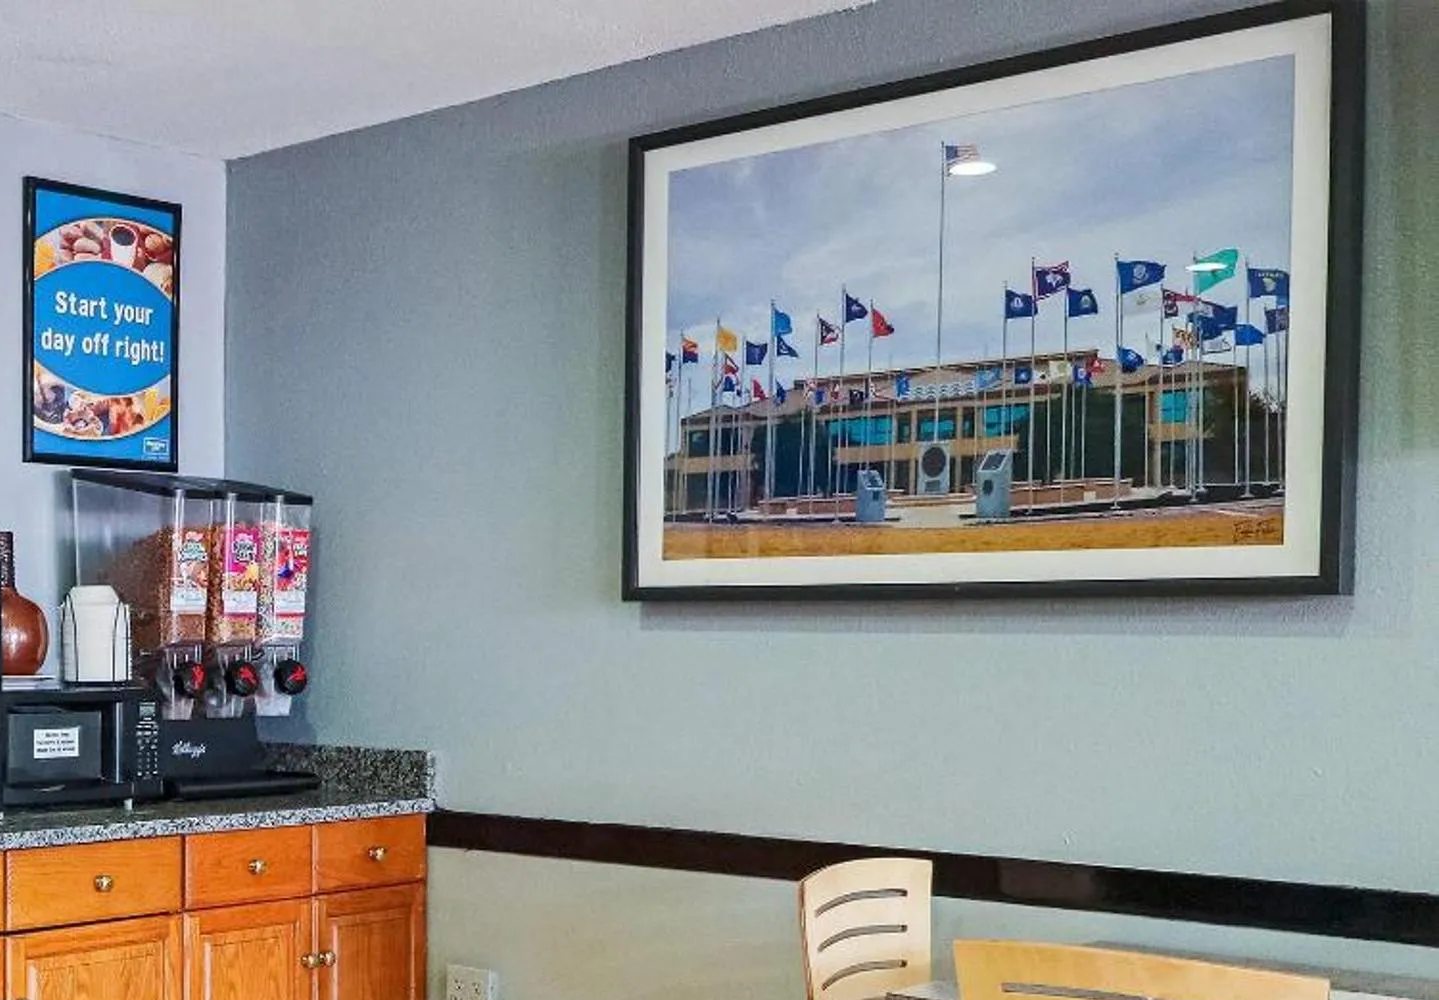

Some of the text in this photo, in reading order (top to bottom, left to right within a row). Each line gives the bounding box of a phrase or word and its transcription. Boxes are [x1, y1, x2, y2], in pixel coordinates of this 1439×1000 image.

[55, 291, 154, 326] Start your
[41, 327, 165, 366] day off right!
